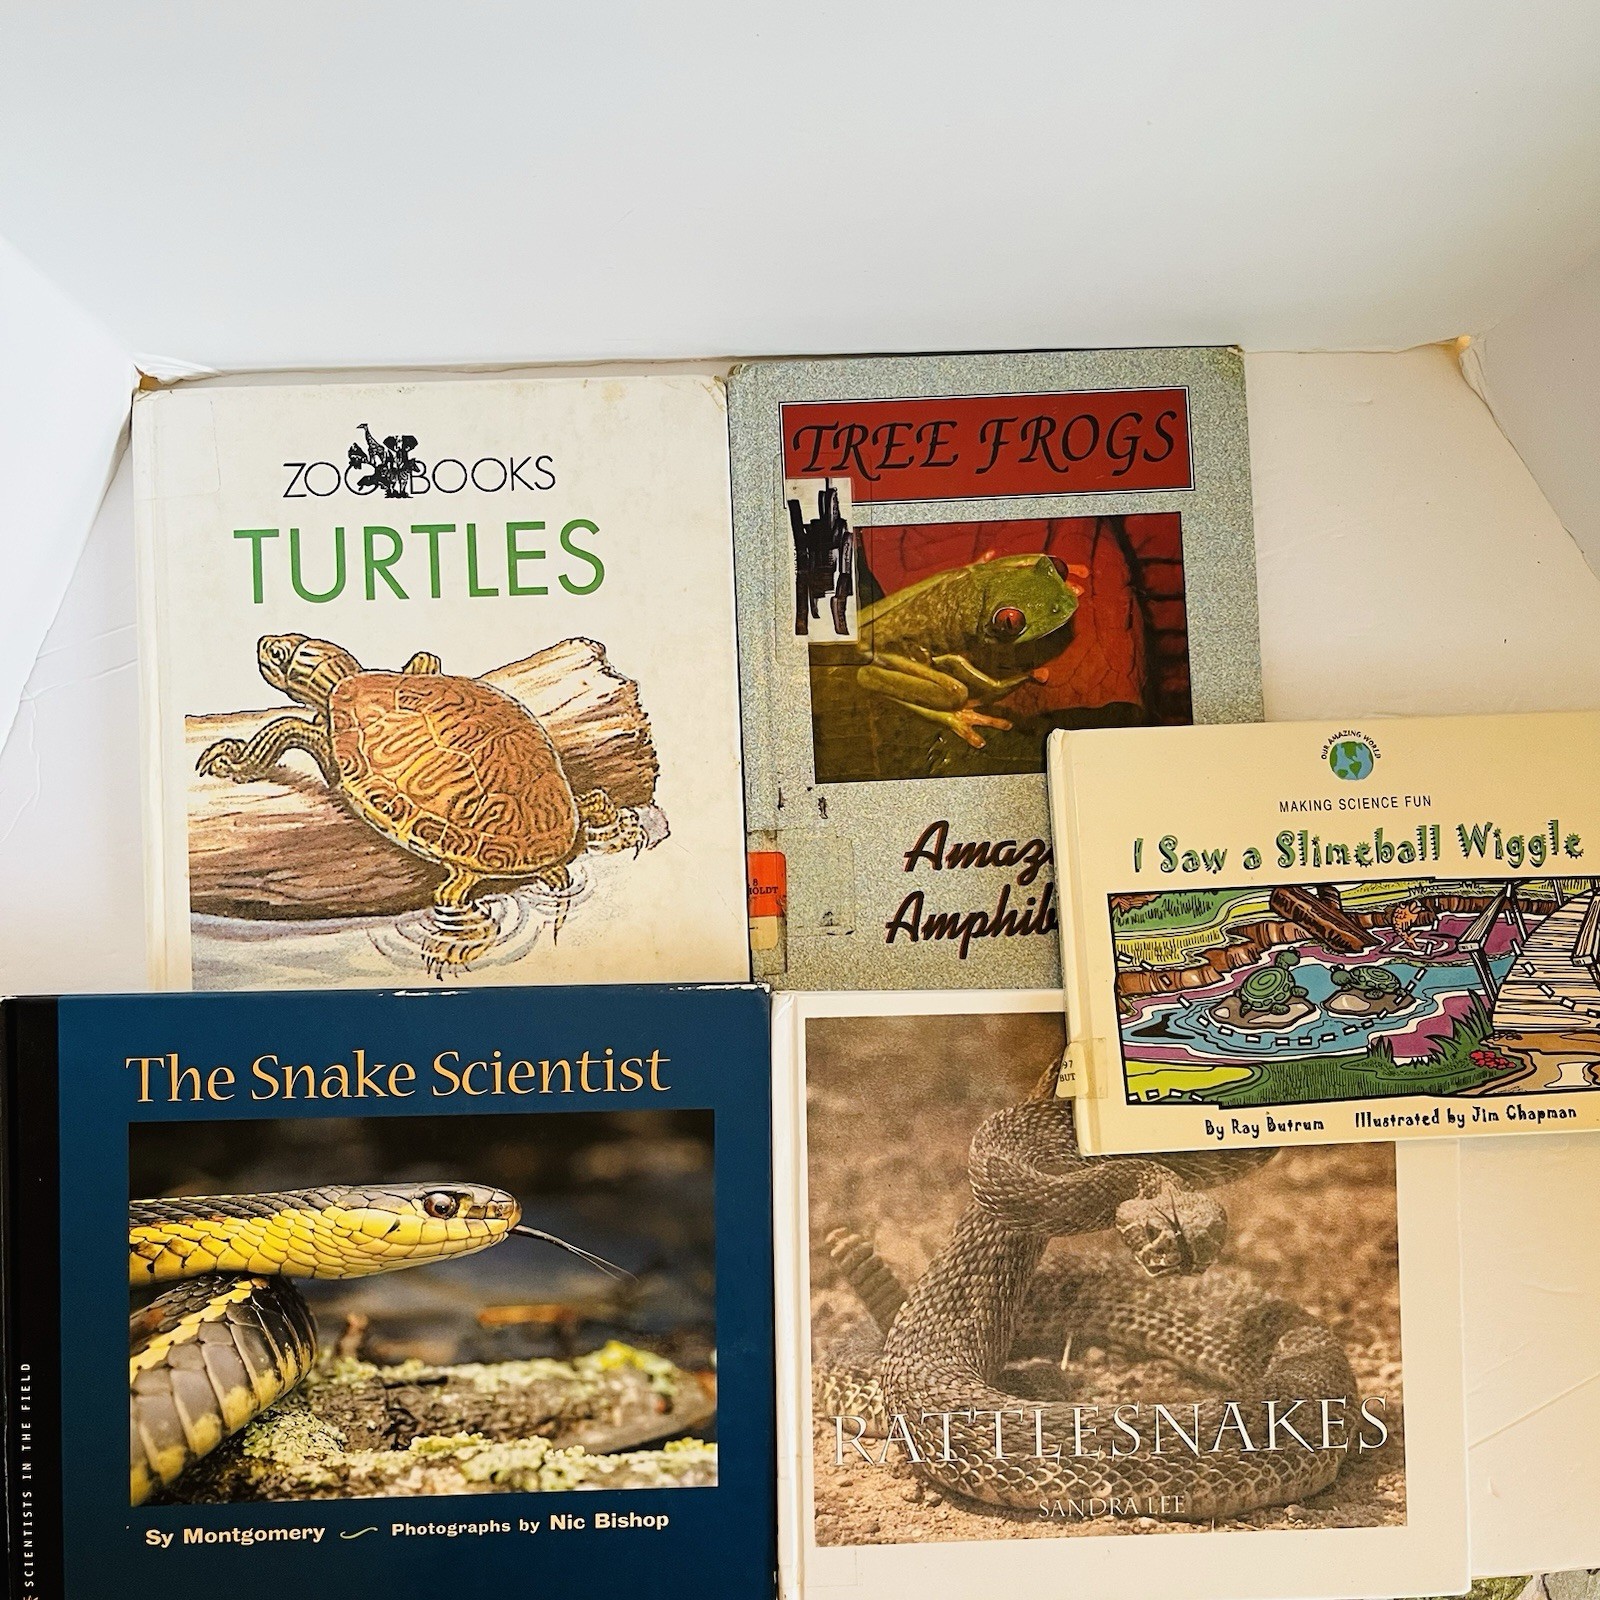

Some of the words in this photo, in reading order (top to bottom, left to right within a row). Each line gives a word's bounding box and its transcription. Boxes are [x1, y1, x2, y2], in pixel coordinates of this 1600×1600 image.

[793, 420, 957, 481] TREE
[974, 409, 1178, 476] FROGS
[233, 516, 605, 604] TURTLES
[1321, 744, 1330, 760] OUR
[1328, 730, 1361, 745] AMAZING
[1363, 734, 1382, 759] WORLD
[1279, 799, 1333, 813] MAKING
[1338, 797, 1399, 811] SCIENCE
[1405, 795, 1432, 808] FUN
[1134, 838, 1144, 873] I
[1158, 833, 1227, 875] Saw
[1242, 848, 1263, 870] a
[1276, 823, 1440, 869] Slimeball
[1456, 819, 1585, 868] Wiggle
[125, 1051, 235, 1103] The
[251, 1050, 417, 1100] Snake
[432, 1048, 672, 1096] Scientist
[1060, 1073, 1076, 1082] BUT
[1205, 1118, 1225, 1140] By
[1231, 1117, 1260, 1138] Ray
[1267, 1115, 1325, 1132] Butrum
[1355, 1112, 1440, 1128] Illustrated
[1448, 1108, 1465, 1127] by
[1471, 1106, 1500, 1124] Jim
[1506, 1104, 1577, 1122] Chapman
[20, 1363, 32, 1411] FIELD
[21, 1422, 32, 1452] THE
[833, 1396, 1391, 1467] RATTLESNAKES
[22, 1463, 32, 1480] IN
[1038, 1496, 1141, 1519] SANDRA
[1148, 1494, 1187, 1515] LEE
[22, 1491, 34, 1587] SCIENTISTS
[146, 1529, 174, 1548] Sy
[183, 1524, 326, 1545] Montgomery
[391, 1520, 511, 1540] Photographs
[519, 1518, 540, 1537] by
[550, 1514, 586, 1532] Nic
[594, 1512, 670, 1532] Bishop
